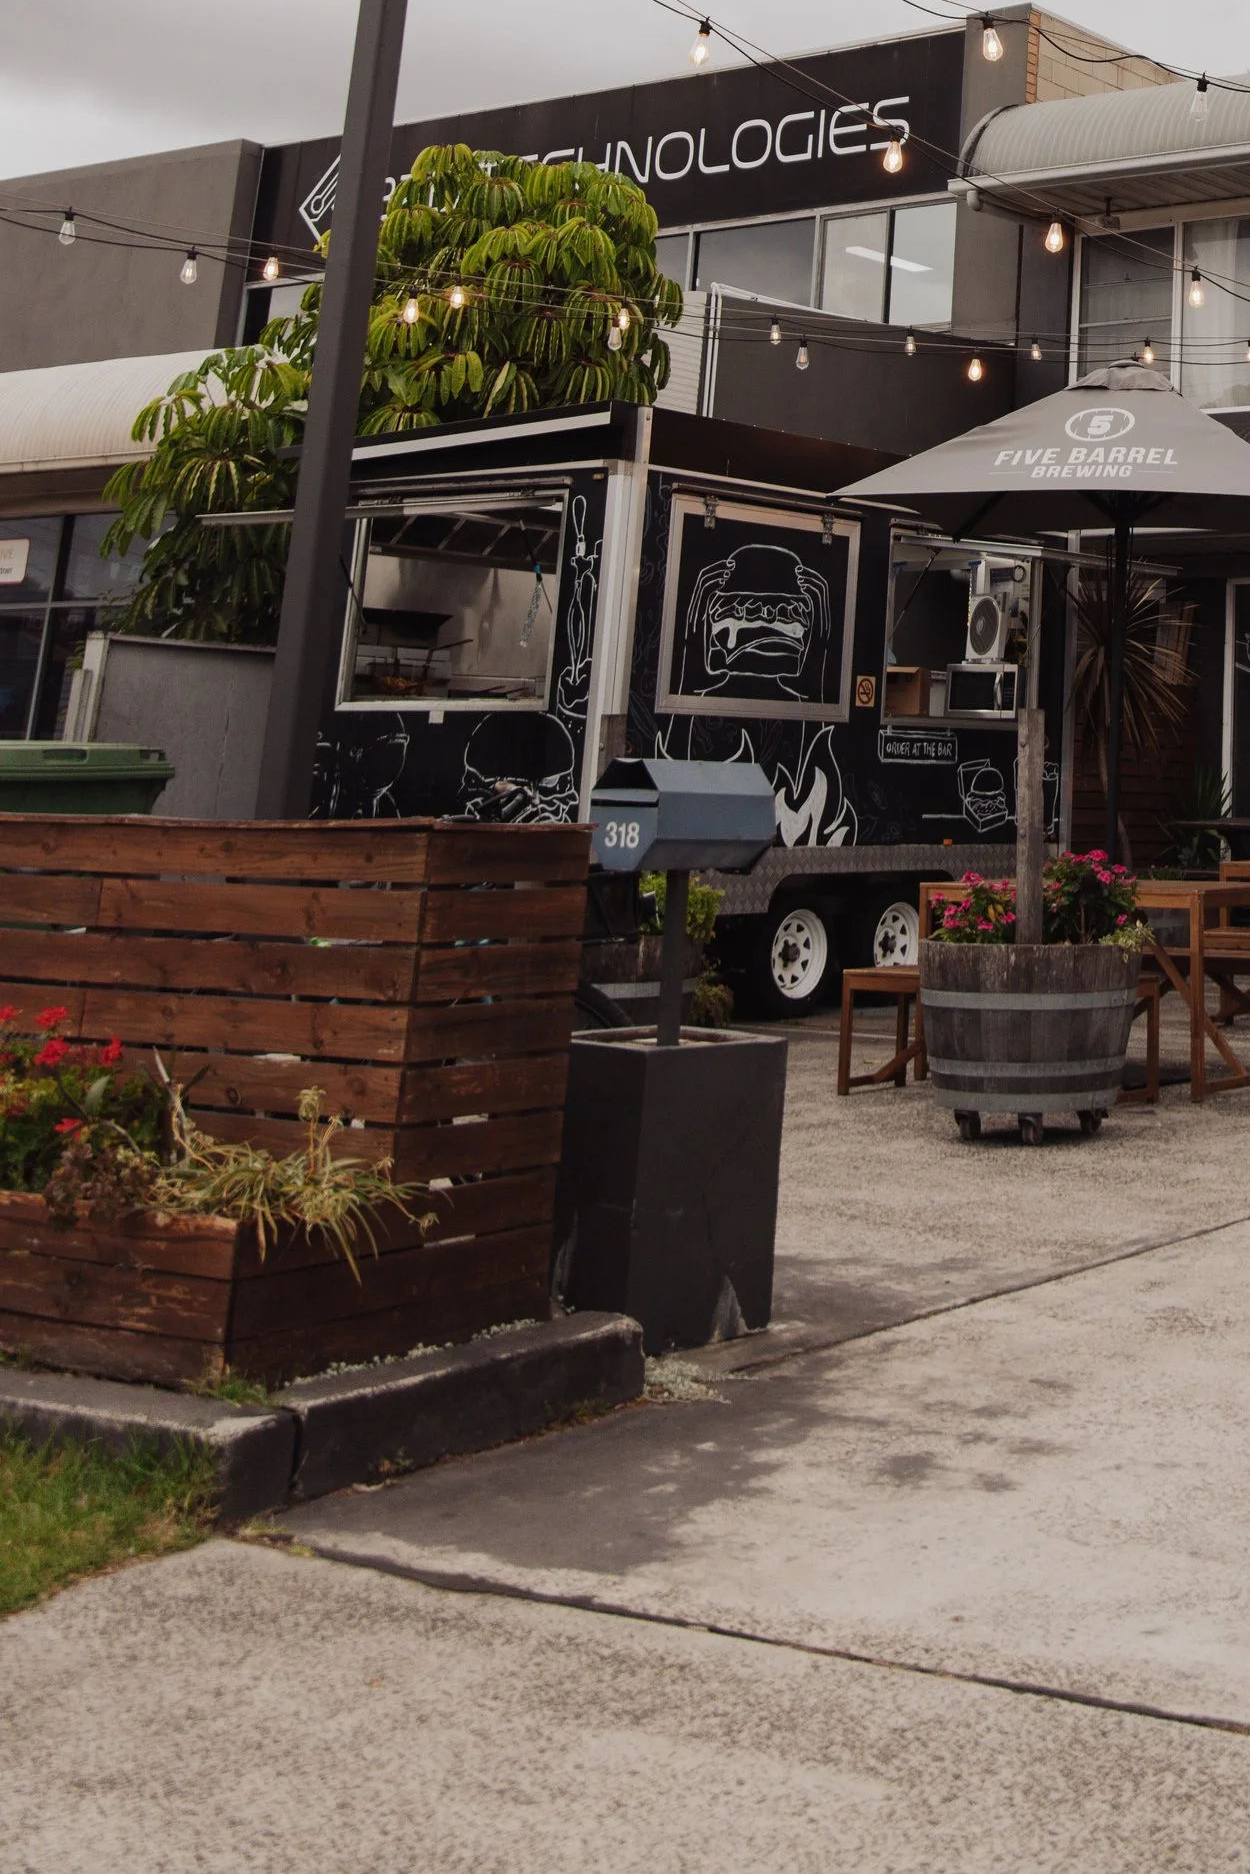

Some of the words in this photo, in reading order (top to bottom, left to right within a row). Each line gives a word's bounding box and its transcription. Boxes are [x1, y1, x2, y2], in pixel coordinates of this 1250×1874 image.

[1087, 414, 1114, 435] 5
[993, 447, 1061, 466] FIVE
[1067, 446, 1179, 465] BARREL
[1031, 465, 1133, 478] BREWING
[886, 741, 910, 757] ORDER
[912, 742, 922, 757] AT
[923, 741, 935, 757] THE
[937, 742, 953, 757] BAR
[604, 821, 640, 849] 318
